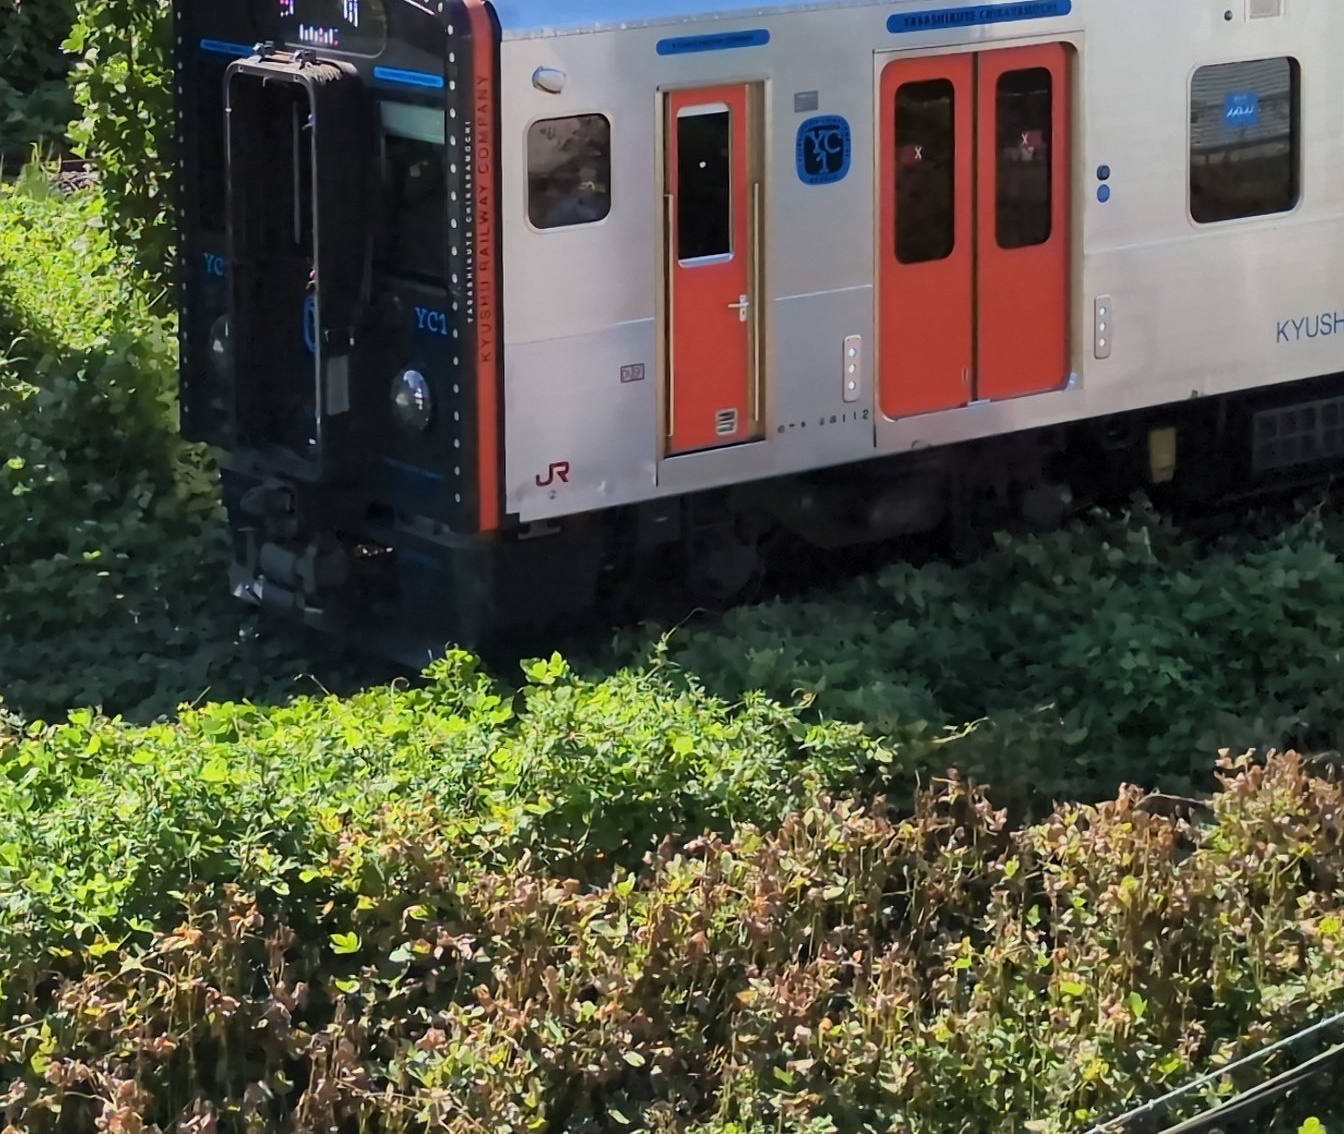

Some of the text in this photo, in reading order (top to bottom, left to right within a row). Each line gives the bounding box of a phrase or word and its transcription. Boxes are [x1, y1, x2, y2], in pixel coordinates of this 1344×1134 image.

[477, 76, 491, 363] KYUSHU RAILWAY COMPANY
[204, 253, 225, 276] YC
[414, 307, 449, 336] YC1
[536, 461, 570, 487] JR
